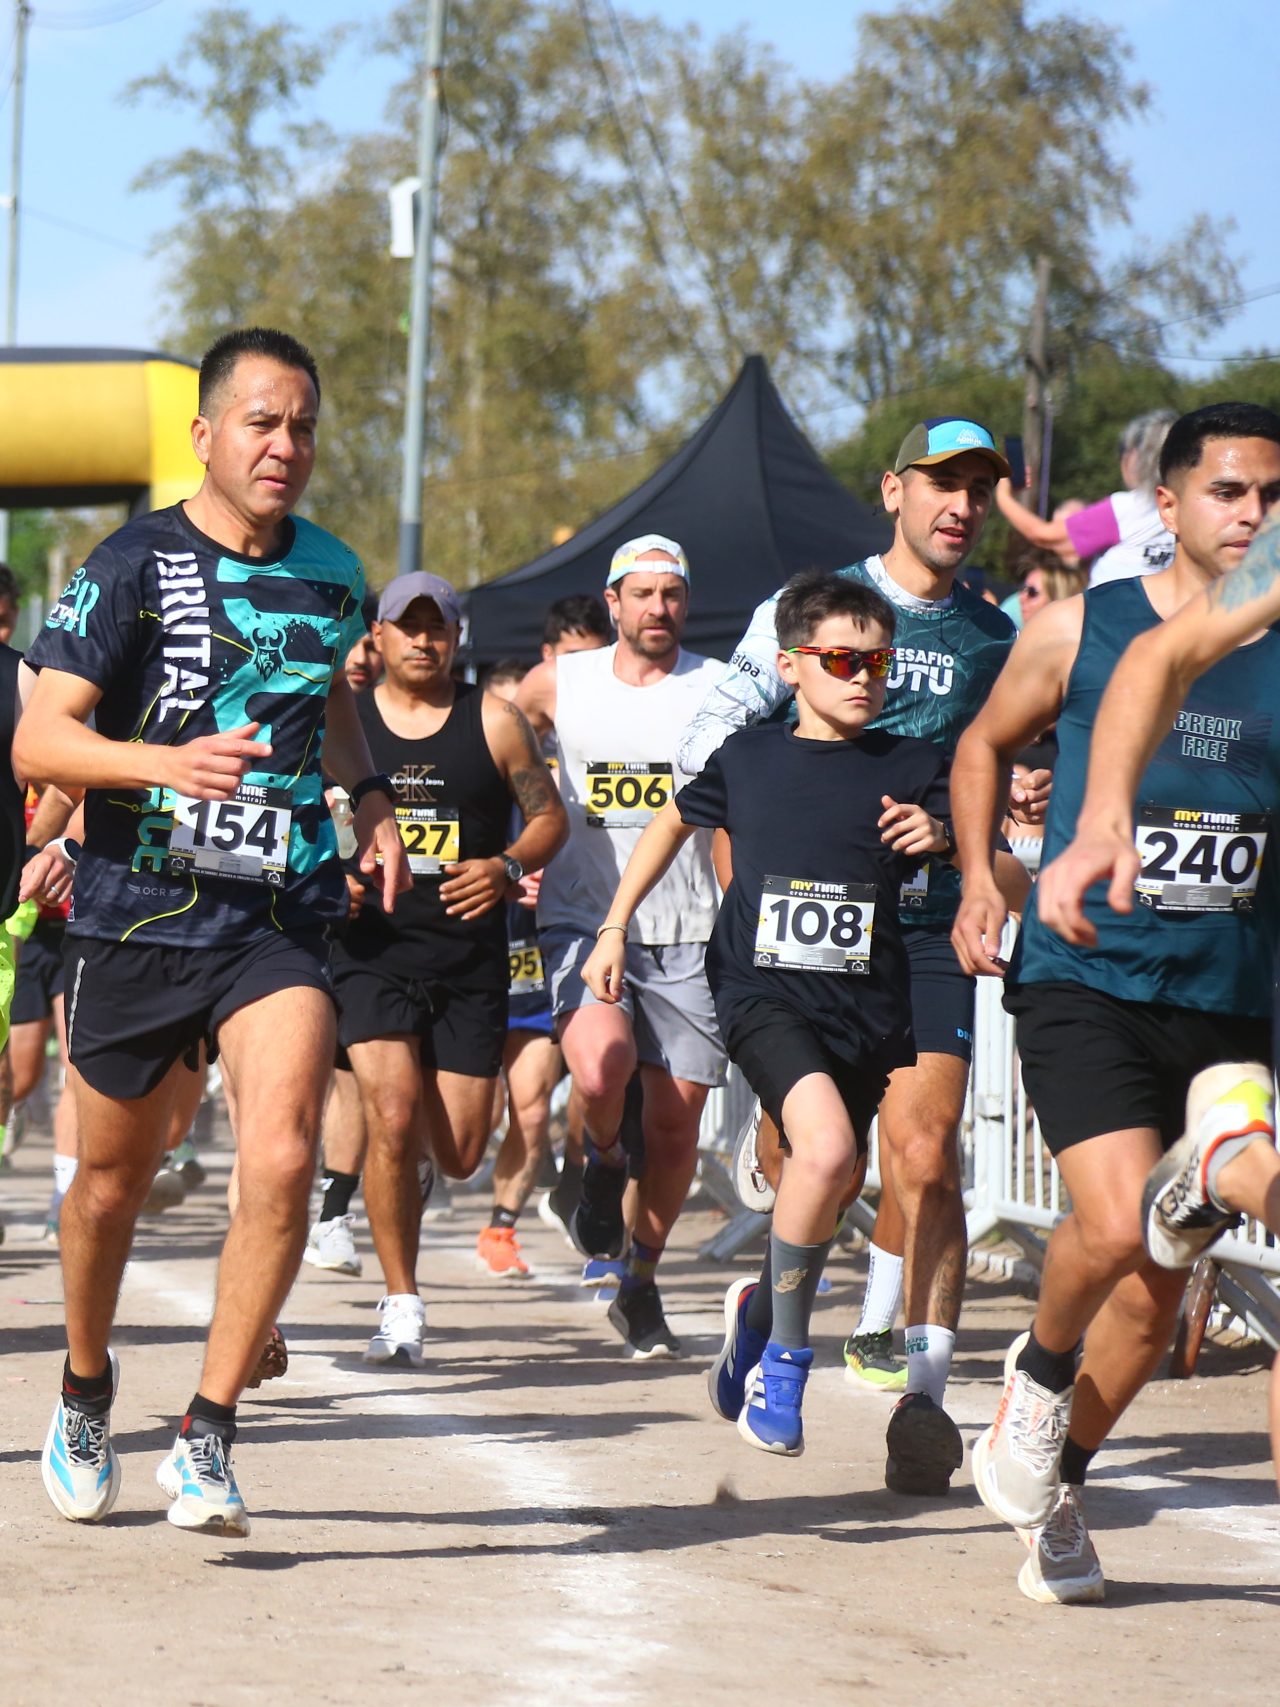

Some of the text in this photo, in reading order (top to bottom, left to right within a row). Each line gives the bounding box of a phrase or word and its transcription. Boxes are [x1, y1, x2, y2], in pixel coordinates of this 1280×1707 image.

[153, 550, 212, 723] BRUTAL
[732, 651, 761, 678] alpa
[895, 647, 955, 668] ESAFIO
[1173, 710, 1243, 741] BREAK
[1182, 734, 1228, 762] FREE
[235, 795, 268, 805] metraje
[591, 776, 668, 808] 506
[187, 800, 279, 857] 154
[1173, 810, 1242, 825] MYTIME
[1173, 822, 1241, 833] cronometraje
[401, 824, 451, 855] 27
[1140, 830, 1259, 885] 240
[142, 886, 167, 897] OCR
[789, 890, 849, 901] cronometraje
[790, 880, 849, 895] MYTIME
[770, 898, 863, 949] 108
[509, 951, 537, 977] 95
